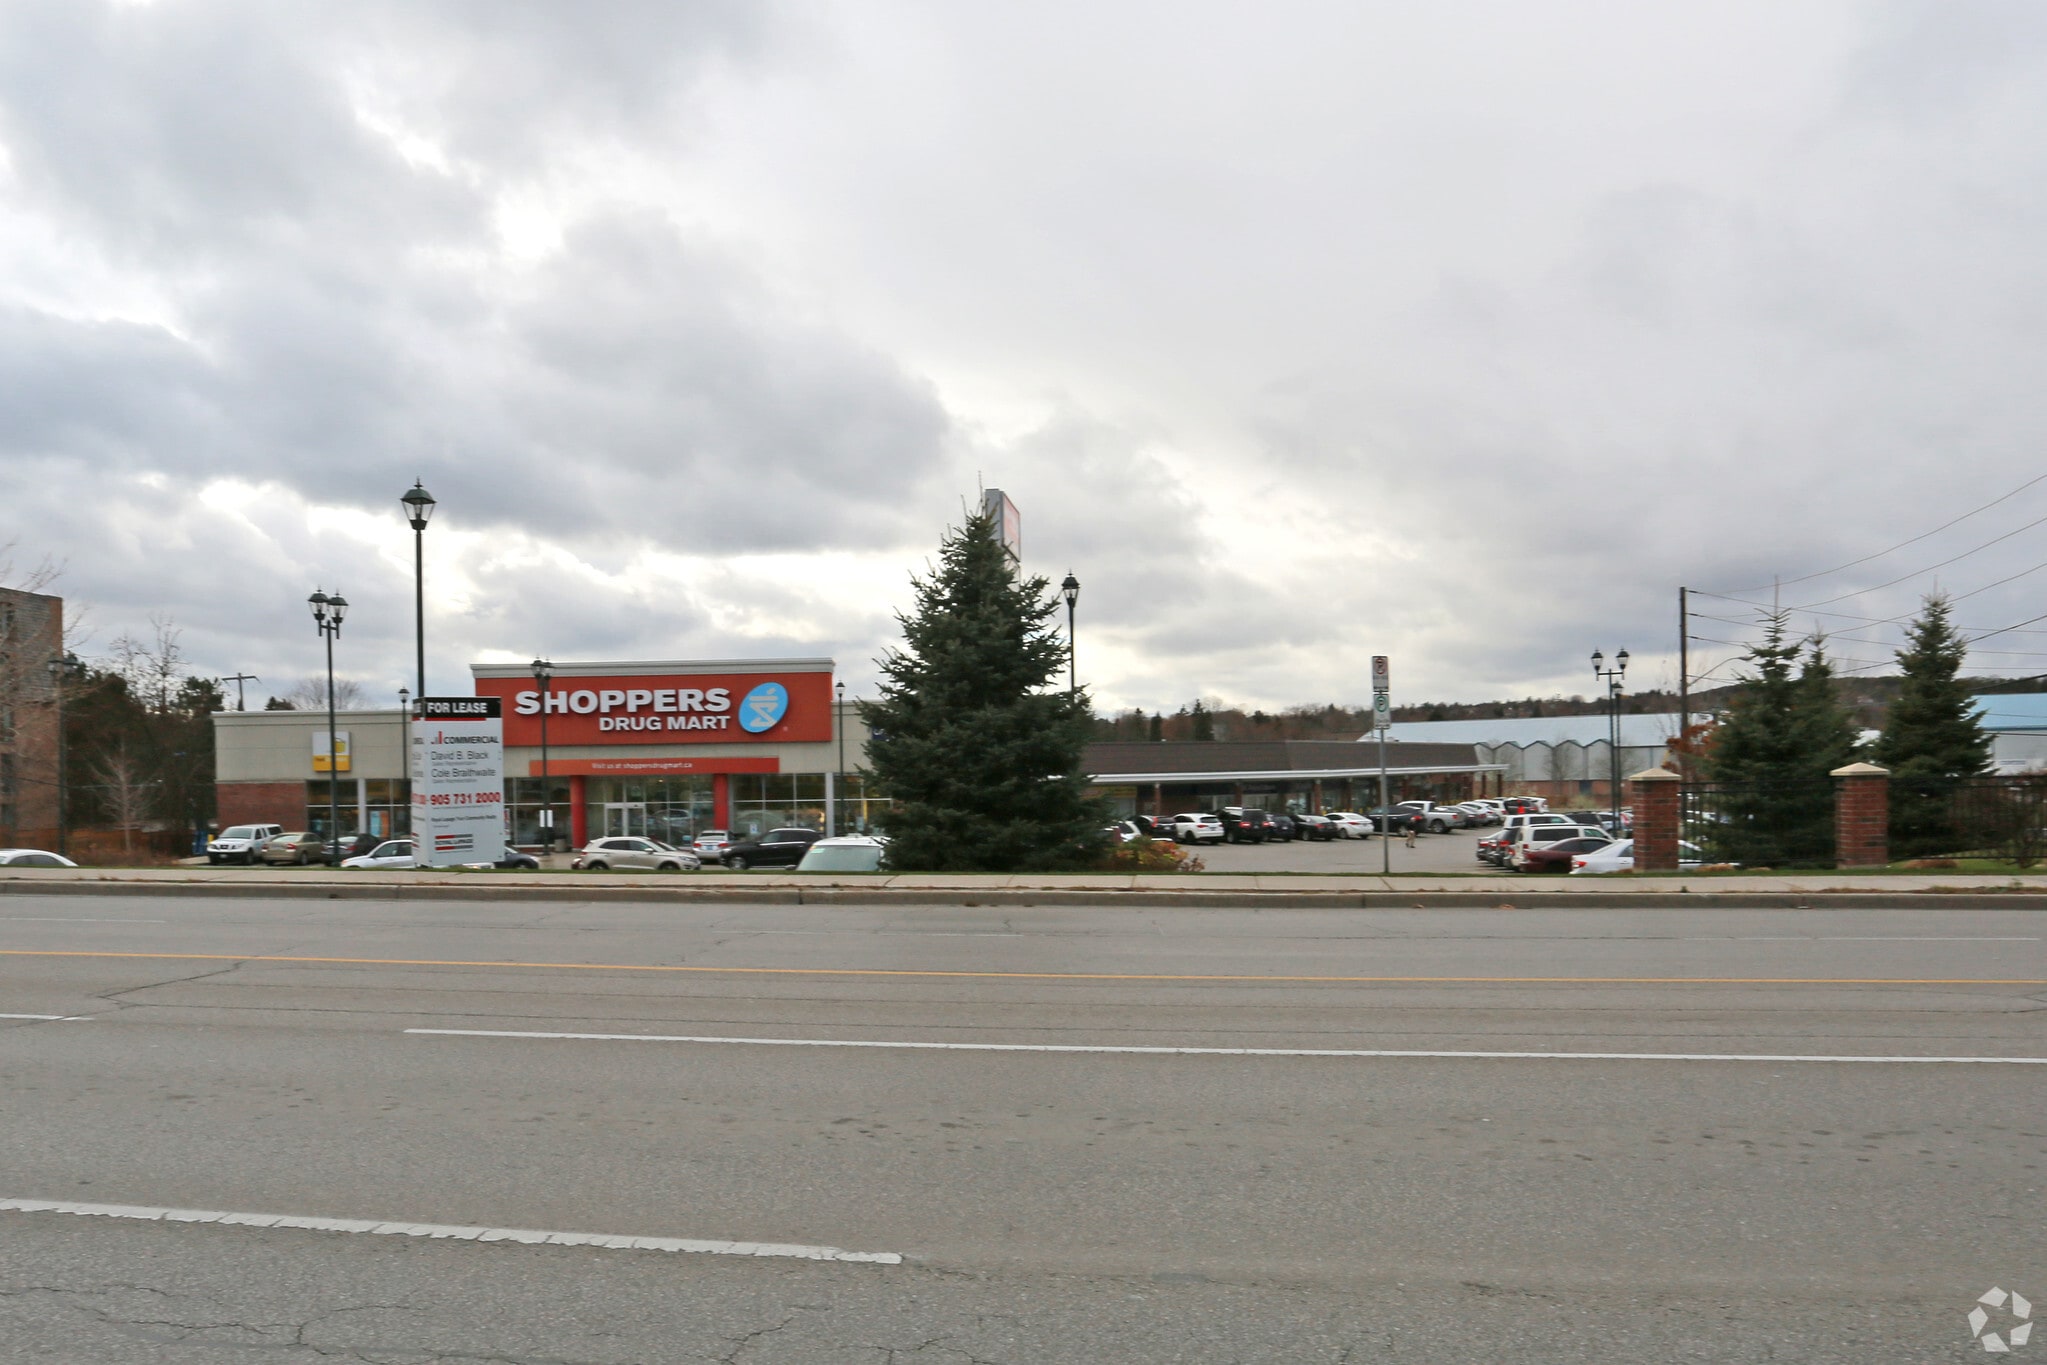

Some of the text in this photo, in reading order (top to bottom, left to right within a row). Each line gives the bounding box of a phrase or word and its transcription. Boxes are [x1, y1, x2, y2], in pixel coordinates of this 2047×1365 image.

[427, 702, 450, 713] FOR
[452, 702, 488, 713] LEASE
[514, 688, 732, 715] SHOPPERS
[599, 715, 731, 731] DRUG MART
[444, 735, 499, 744] COMMERCIAL
[430, 793, 451, 805] 905
[453, 793, 473, 804] 731
[475, 791, 501, 803] 2000
